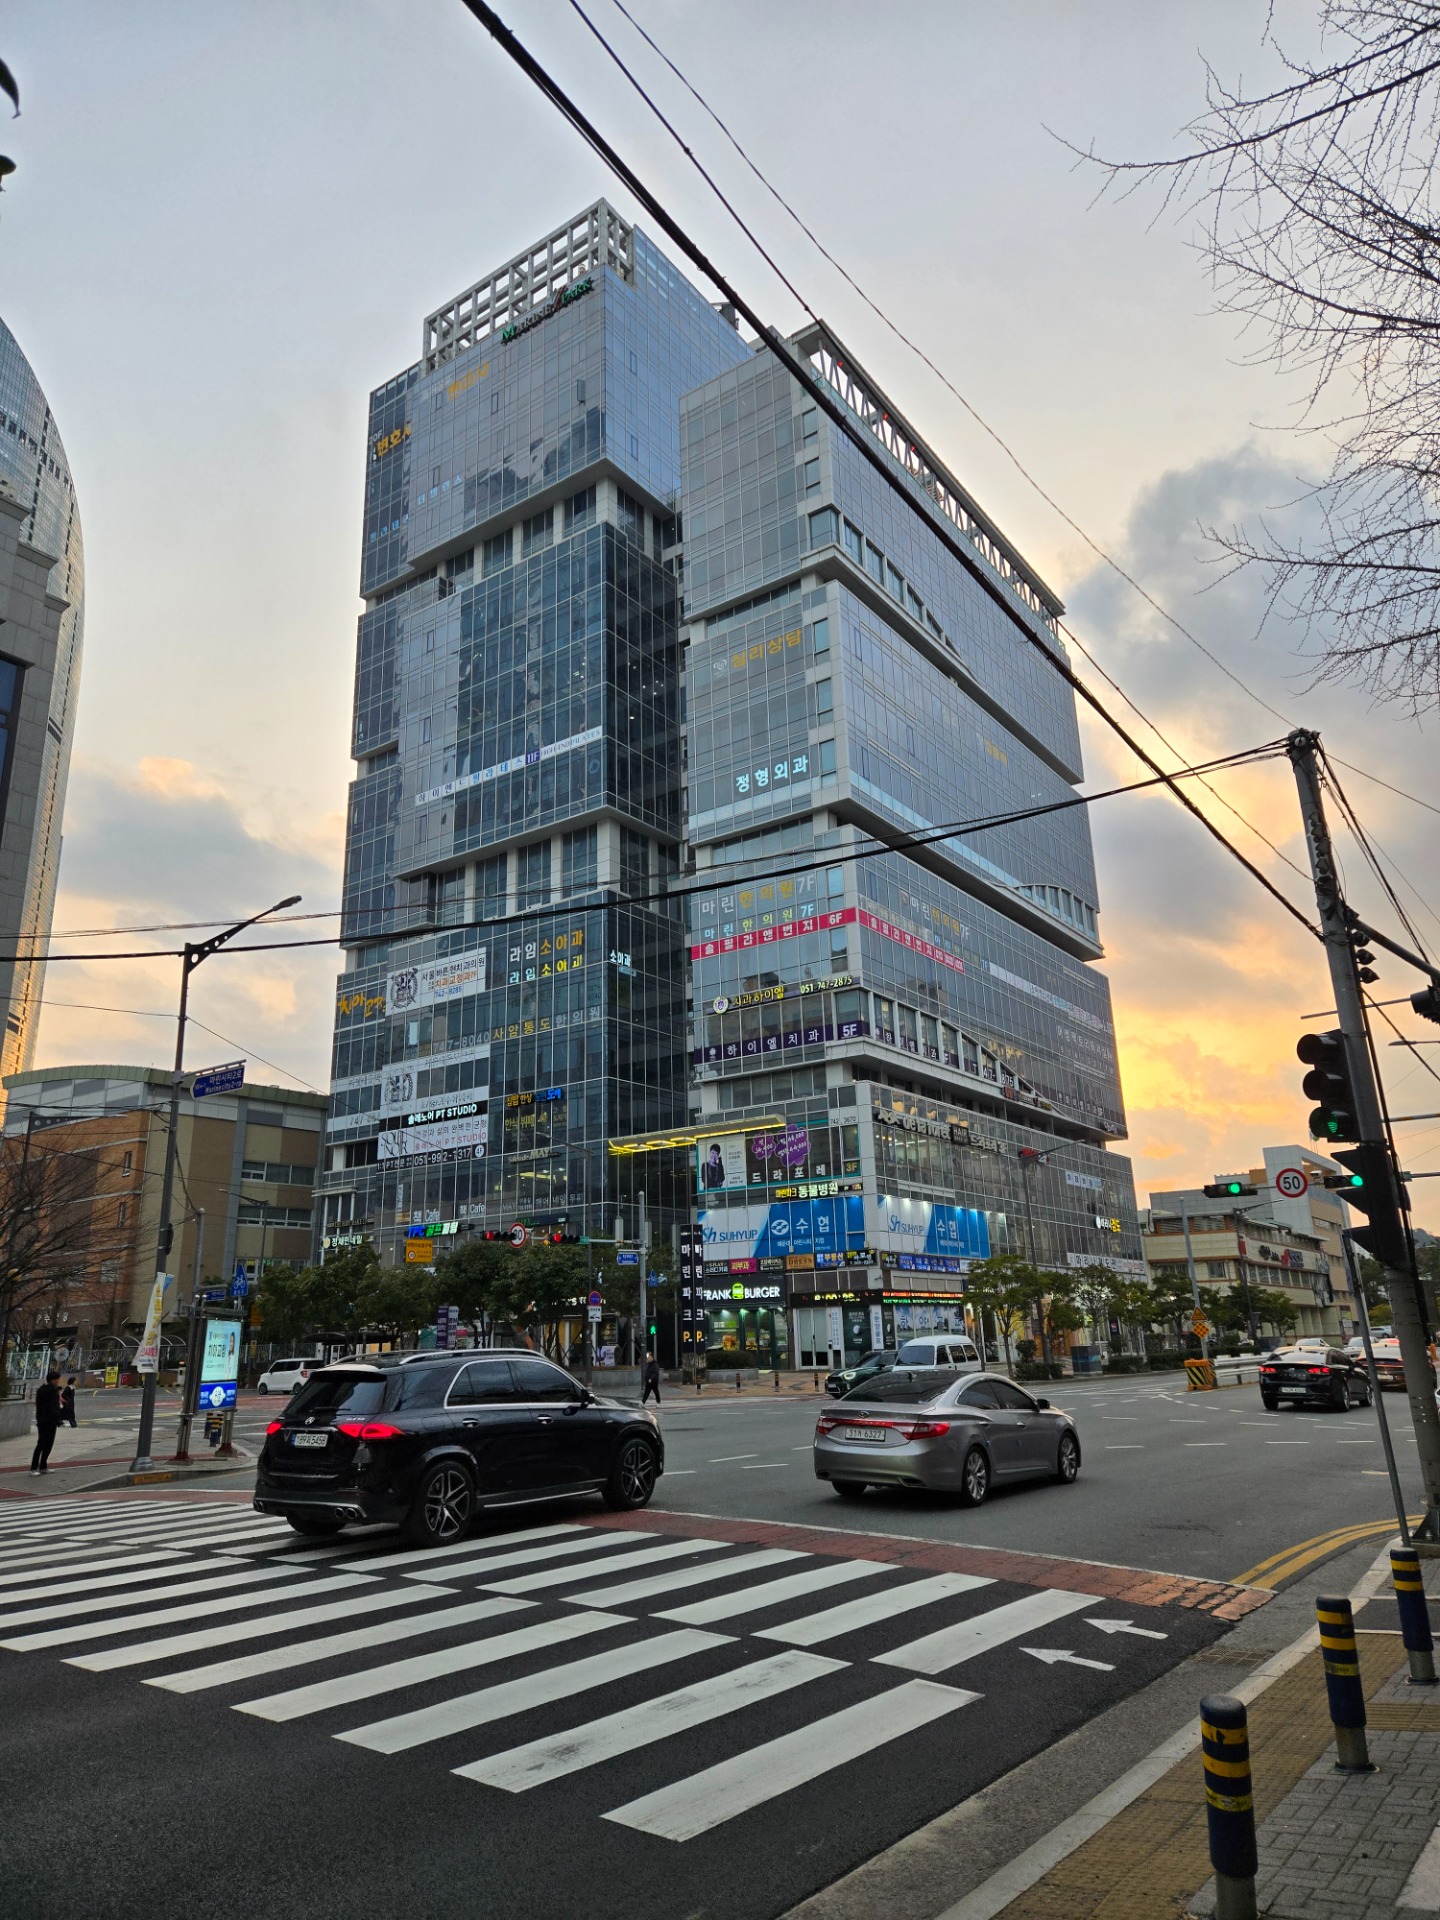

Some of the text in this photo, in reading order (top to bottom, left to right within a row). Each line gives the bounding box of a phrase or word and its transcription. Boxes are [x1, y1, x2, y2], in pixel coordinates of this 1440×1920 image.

[562, 279, 590, 305] PARK
[731, 628, 803, 670] 심리상담
[526, 752, 540, 764] 11F
[735, 754, 808, 793] 정형외과
[701, 874, 815, 916] 마린한의원 7F
[704, 903, 814, 940] 마린한의원 7F
[829, 912, 842, 926] 6F
[509, 929, 583, 963] 라임소아과
[609, 949, 632, 967] 소아과
[509, 954, 583, 984] 라임소아과
[732, 985, 785, 1007] 치과하이엘
[726, 1023, 857, 1057] 하이엘치과 5F
[435, 1108, 446, 1120] PT
[447, 1103, 477, 1118] STUDIO
[457, 1131, 487, 1144] STUDIO
[953, 1126, 968, 1138] HAIR
[752, 1163, 826, 1183] 드라포레
[845, 1161, 858, 1173] 3F
[798, 1182, 839, 1198] 동물병원
[1283, 1175, 1301, 1190] 50
[424, 1208, 440, 1222] Cafe
[470, 1203, 485, 1215] Cafe
[407, 1224, 426, 1239] TPC
[795, 1215, 830, 1234] 수협
[901, 1221, 925, 1236] SUHYUP
[937, 1218, 958, 1240] 수협
[719, 1229, 758, 1242] SUHYUP
[680, 1243, 692, 1320] 마린파크
[703, 1286, 780, 1301] FRANK BURGER
[683, 1331, 690, 1342] P
[696, 1330, 703, 1342] P
